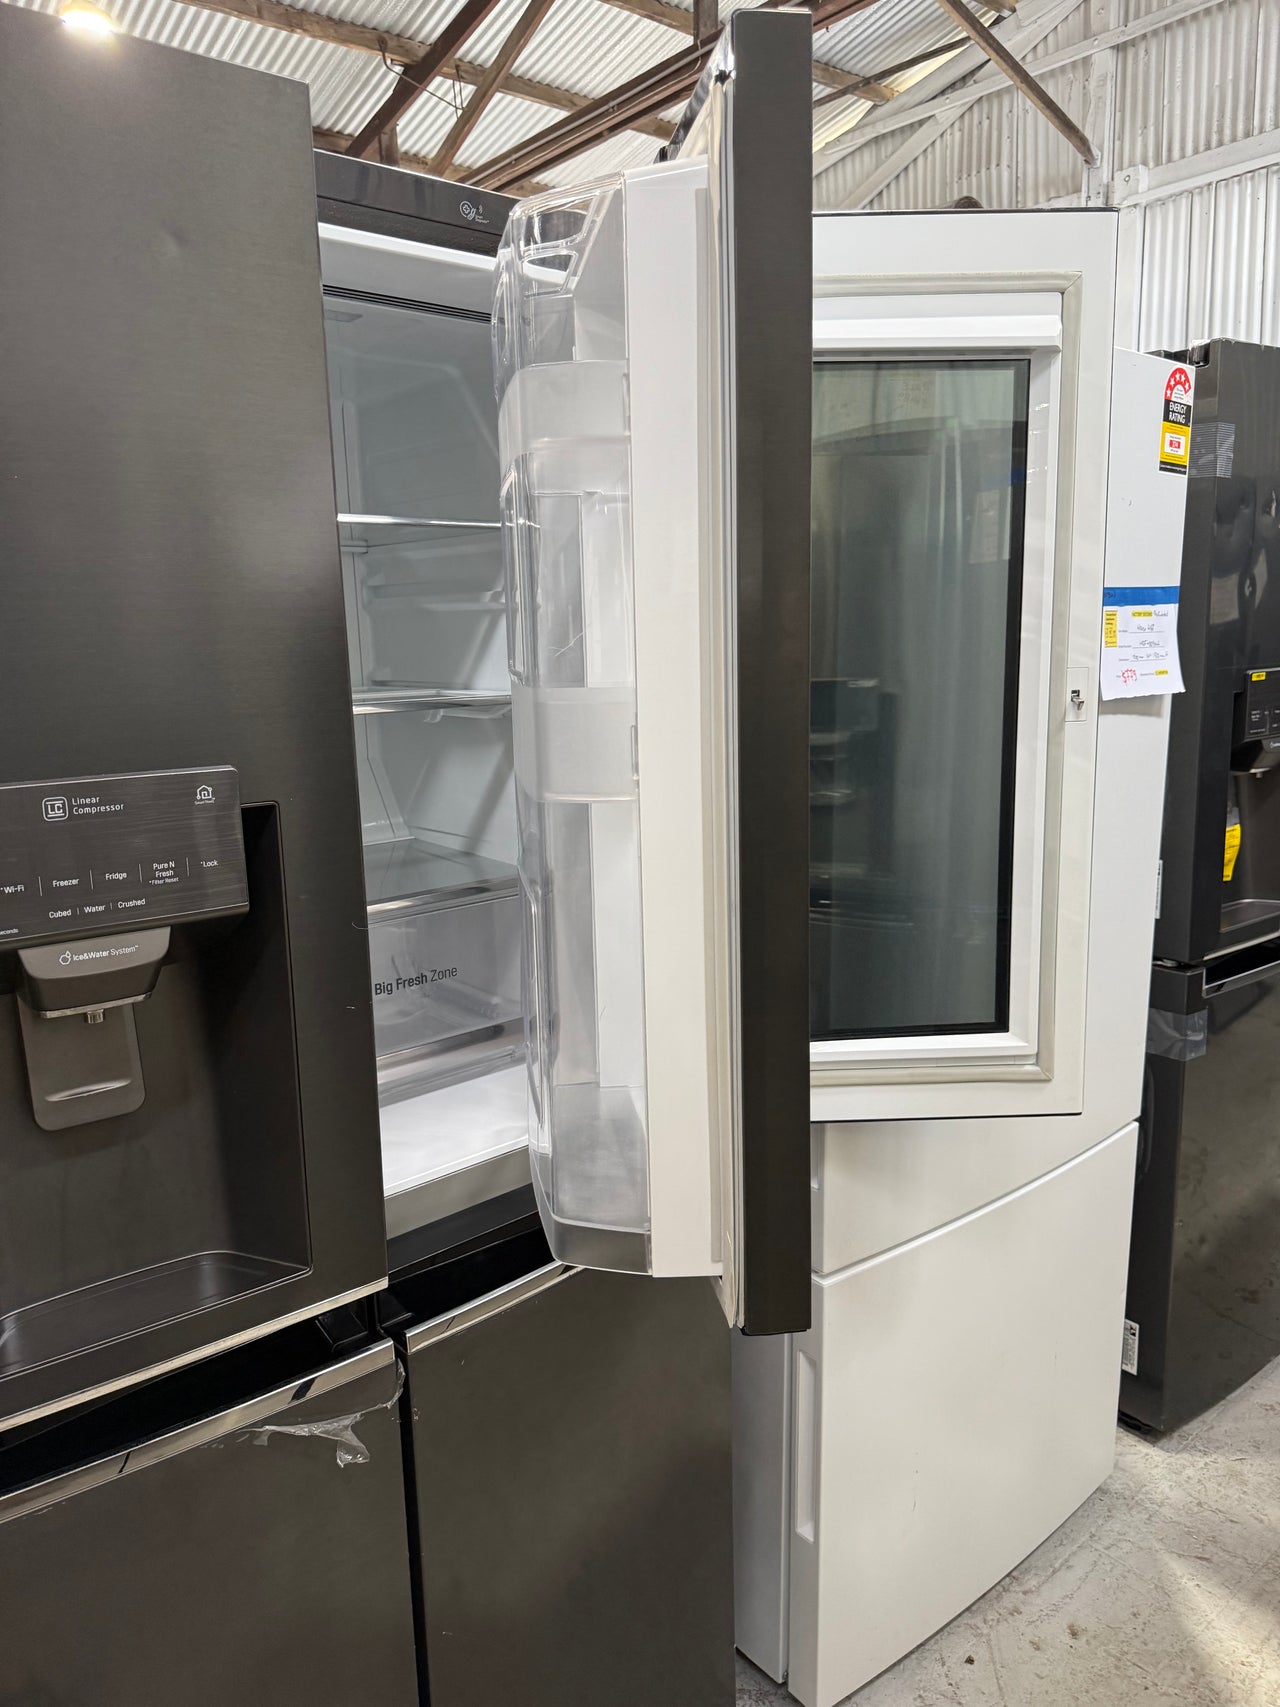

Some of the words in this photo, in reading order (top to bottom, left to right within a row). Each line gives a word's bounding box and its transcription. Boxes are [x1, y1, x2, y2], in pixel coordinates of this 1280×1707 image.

[1169, 402, 1187, 414] ENERGY
[1168, 413, 1186, 424] RATING
[71, 797, 100, 806] Linear
[73, 804, 125, 815] Compressor
[153, 862, 169, 871] Pure
[169, 860, 175, 868] N
[105, 872, 127, 881] Fridge
[155, 869, 174, 878] Fresh
[52, 878, 80, 888] Freezer
[84, 904, 106, 914] Water
[118, 898, 146, 909] Crushed
[48, 909, 72, 919] Cubed
[73, 950, 110, 962] Ice&Water
[374, 981, 394, 996] Big
[396, 972, 428, 991] Fresh
[430, 966, 458, 982] Zone
